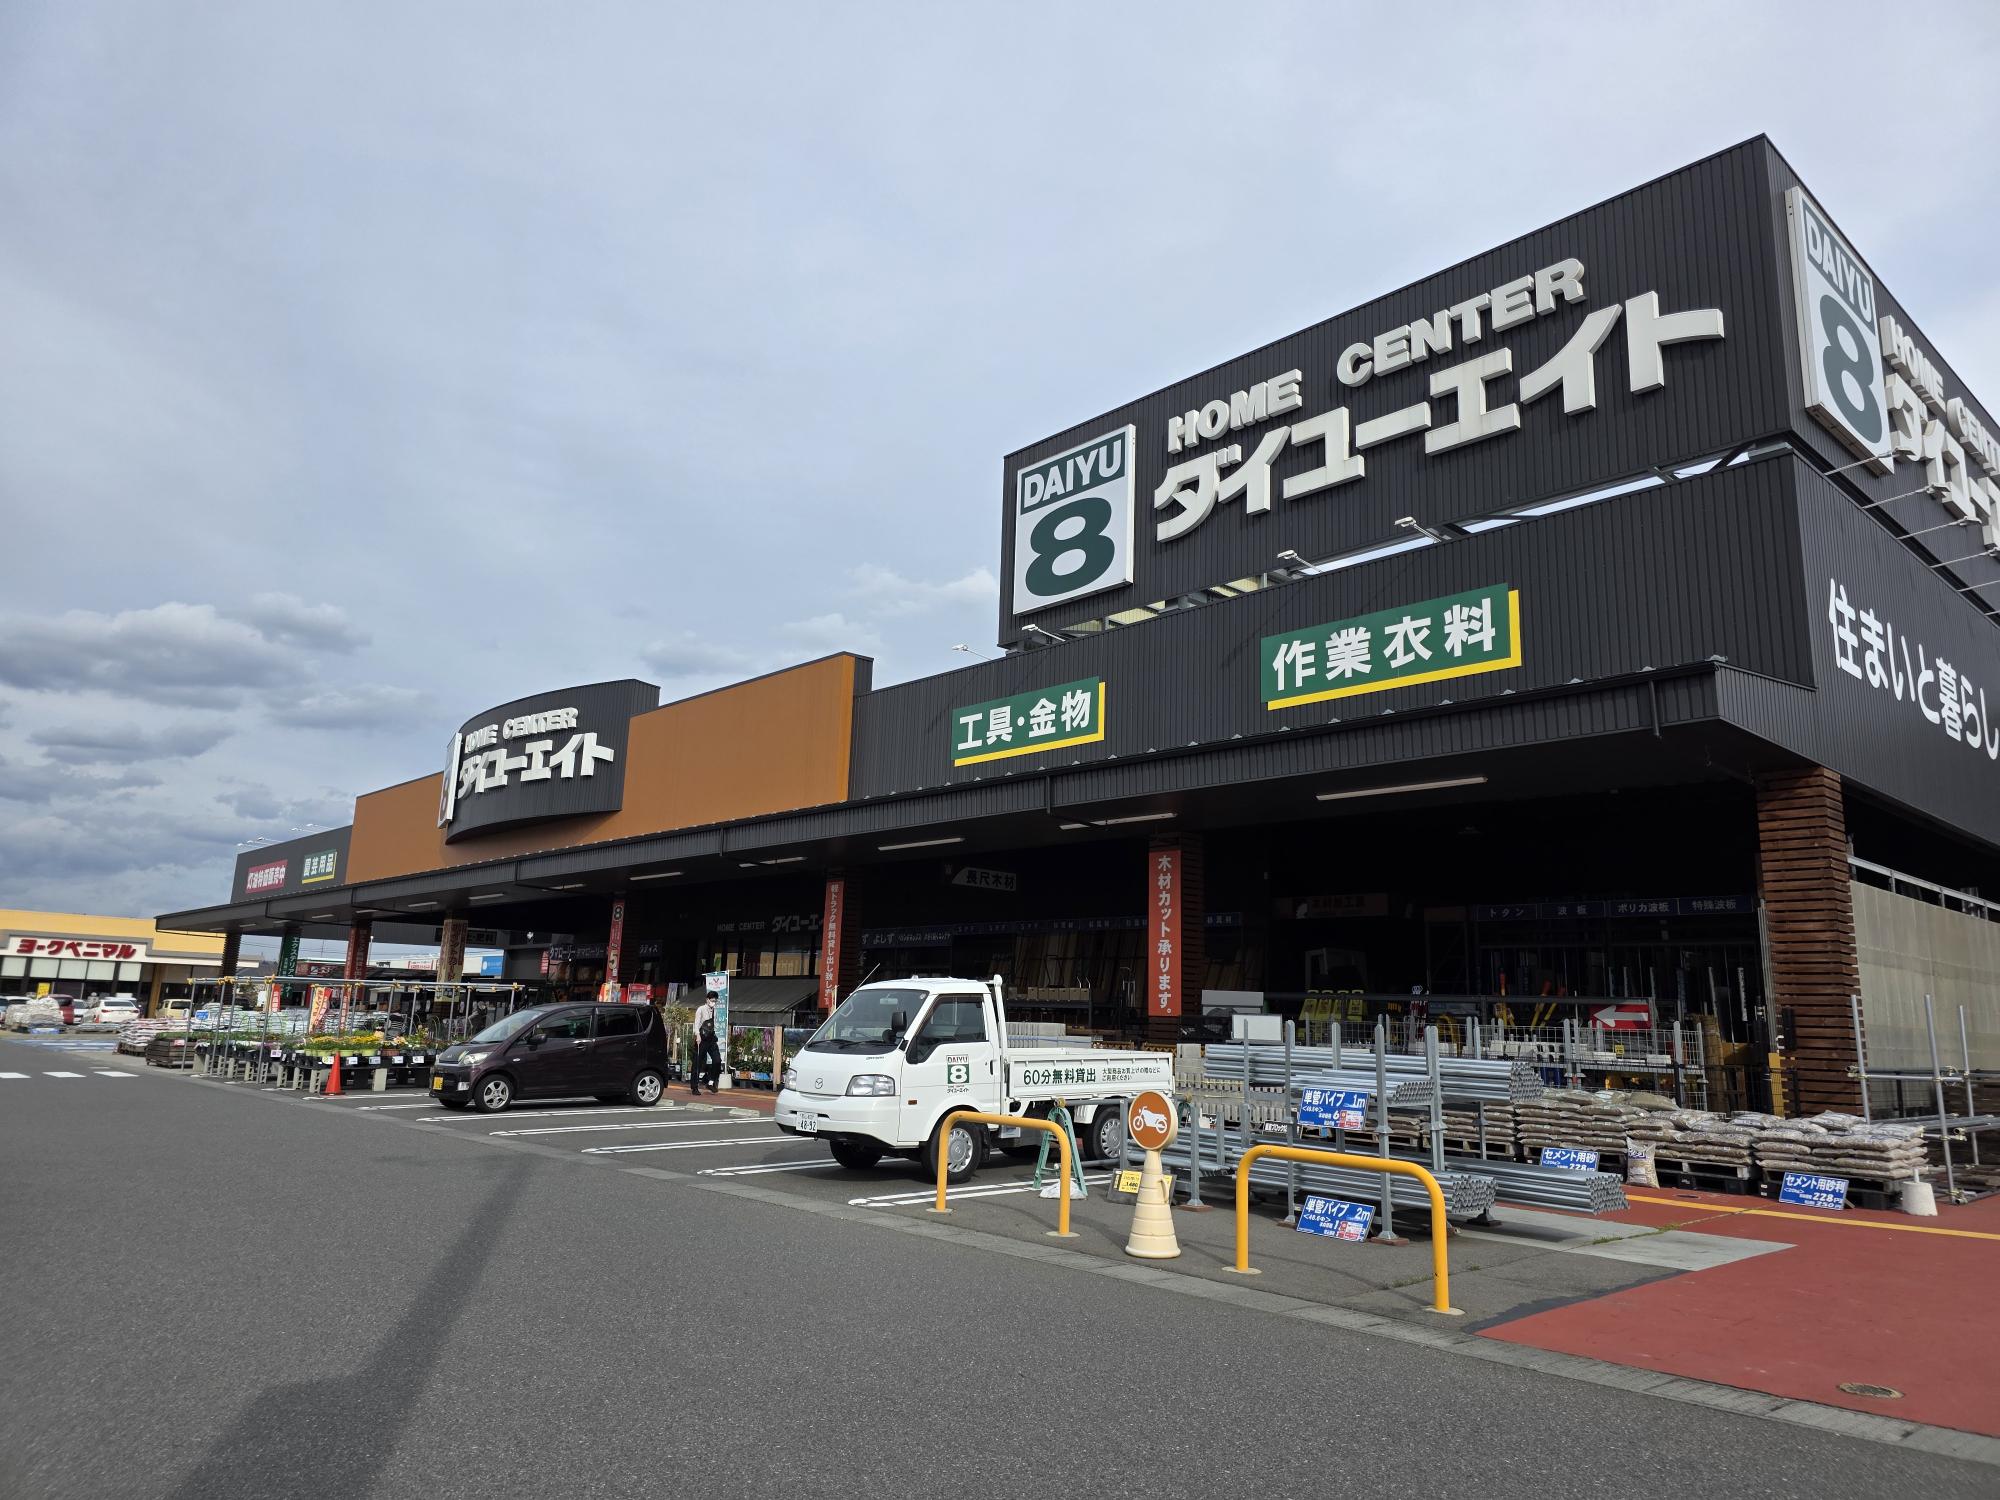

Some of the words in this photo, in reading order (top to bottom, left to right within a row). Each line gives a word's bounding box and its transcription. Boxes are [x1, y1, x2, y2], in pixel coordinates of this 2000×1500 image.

[1805, 217, 1872, 322] DAIYU
[1168, 369, 1302, 454] HOME
[1336, 258, 1586, 387] CENTER
[1820, 294, 1882, 443] 8
[1879, 315, 1947, 416] HOME
[1154, 290, 1725, 542] ダイユーエイト
[1024, 438, 1122, 509] DAIYU
[1025, 497, 1115, 597] 8
[1272, 598, 1496, 691] 作業衣料
[1829, 578, 1999, 760] 住まいと暮らし
[465, 724, 498, 753] HOME
[503, 707, 579, 740] CENTER
[957, 688, 1092, 751] 工具・金物
[458, 732, 615, 799] ダイユーエイト
[16, 938, 137, 960] ヨークベニマル
[1157, 855, 1172, 1014] 木材カット承ります。
[947, 1056, 968, 1064] DAIYU
[950, 1065, 968, 1084] 8
[1023, 1068, 1096, 1085] 60分無料貸出
[1303, 1089, 1346, 1107] 単管パイプ
[1352, 1093, 1366, 1108] 1m
[1544, 1149, 1596, 1164] セメント用砂
[1785, 1174, 1846, 1194] セメント用砂利
[1305, 1198, 1350, 1218] 単管パイプ
[1354, 1207, 1371, 1222] 2m
